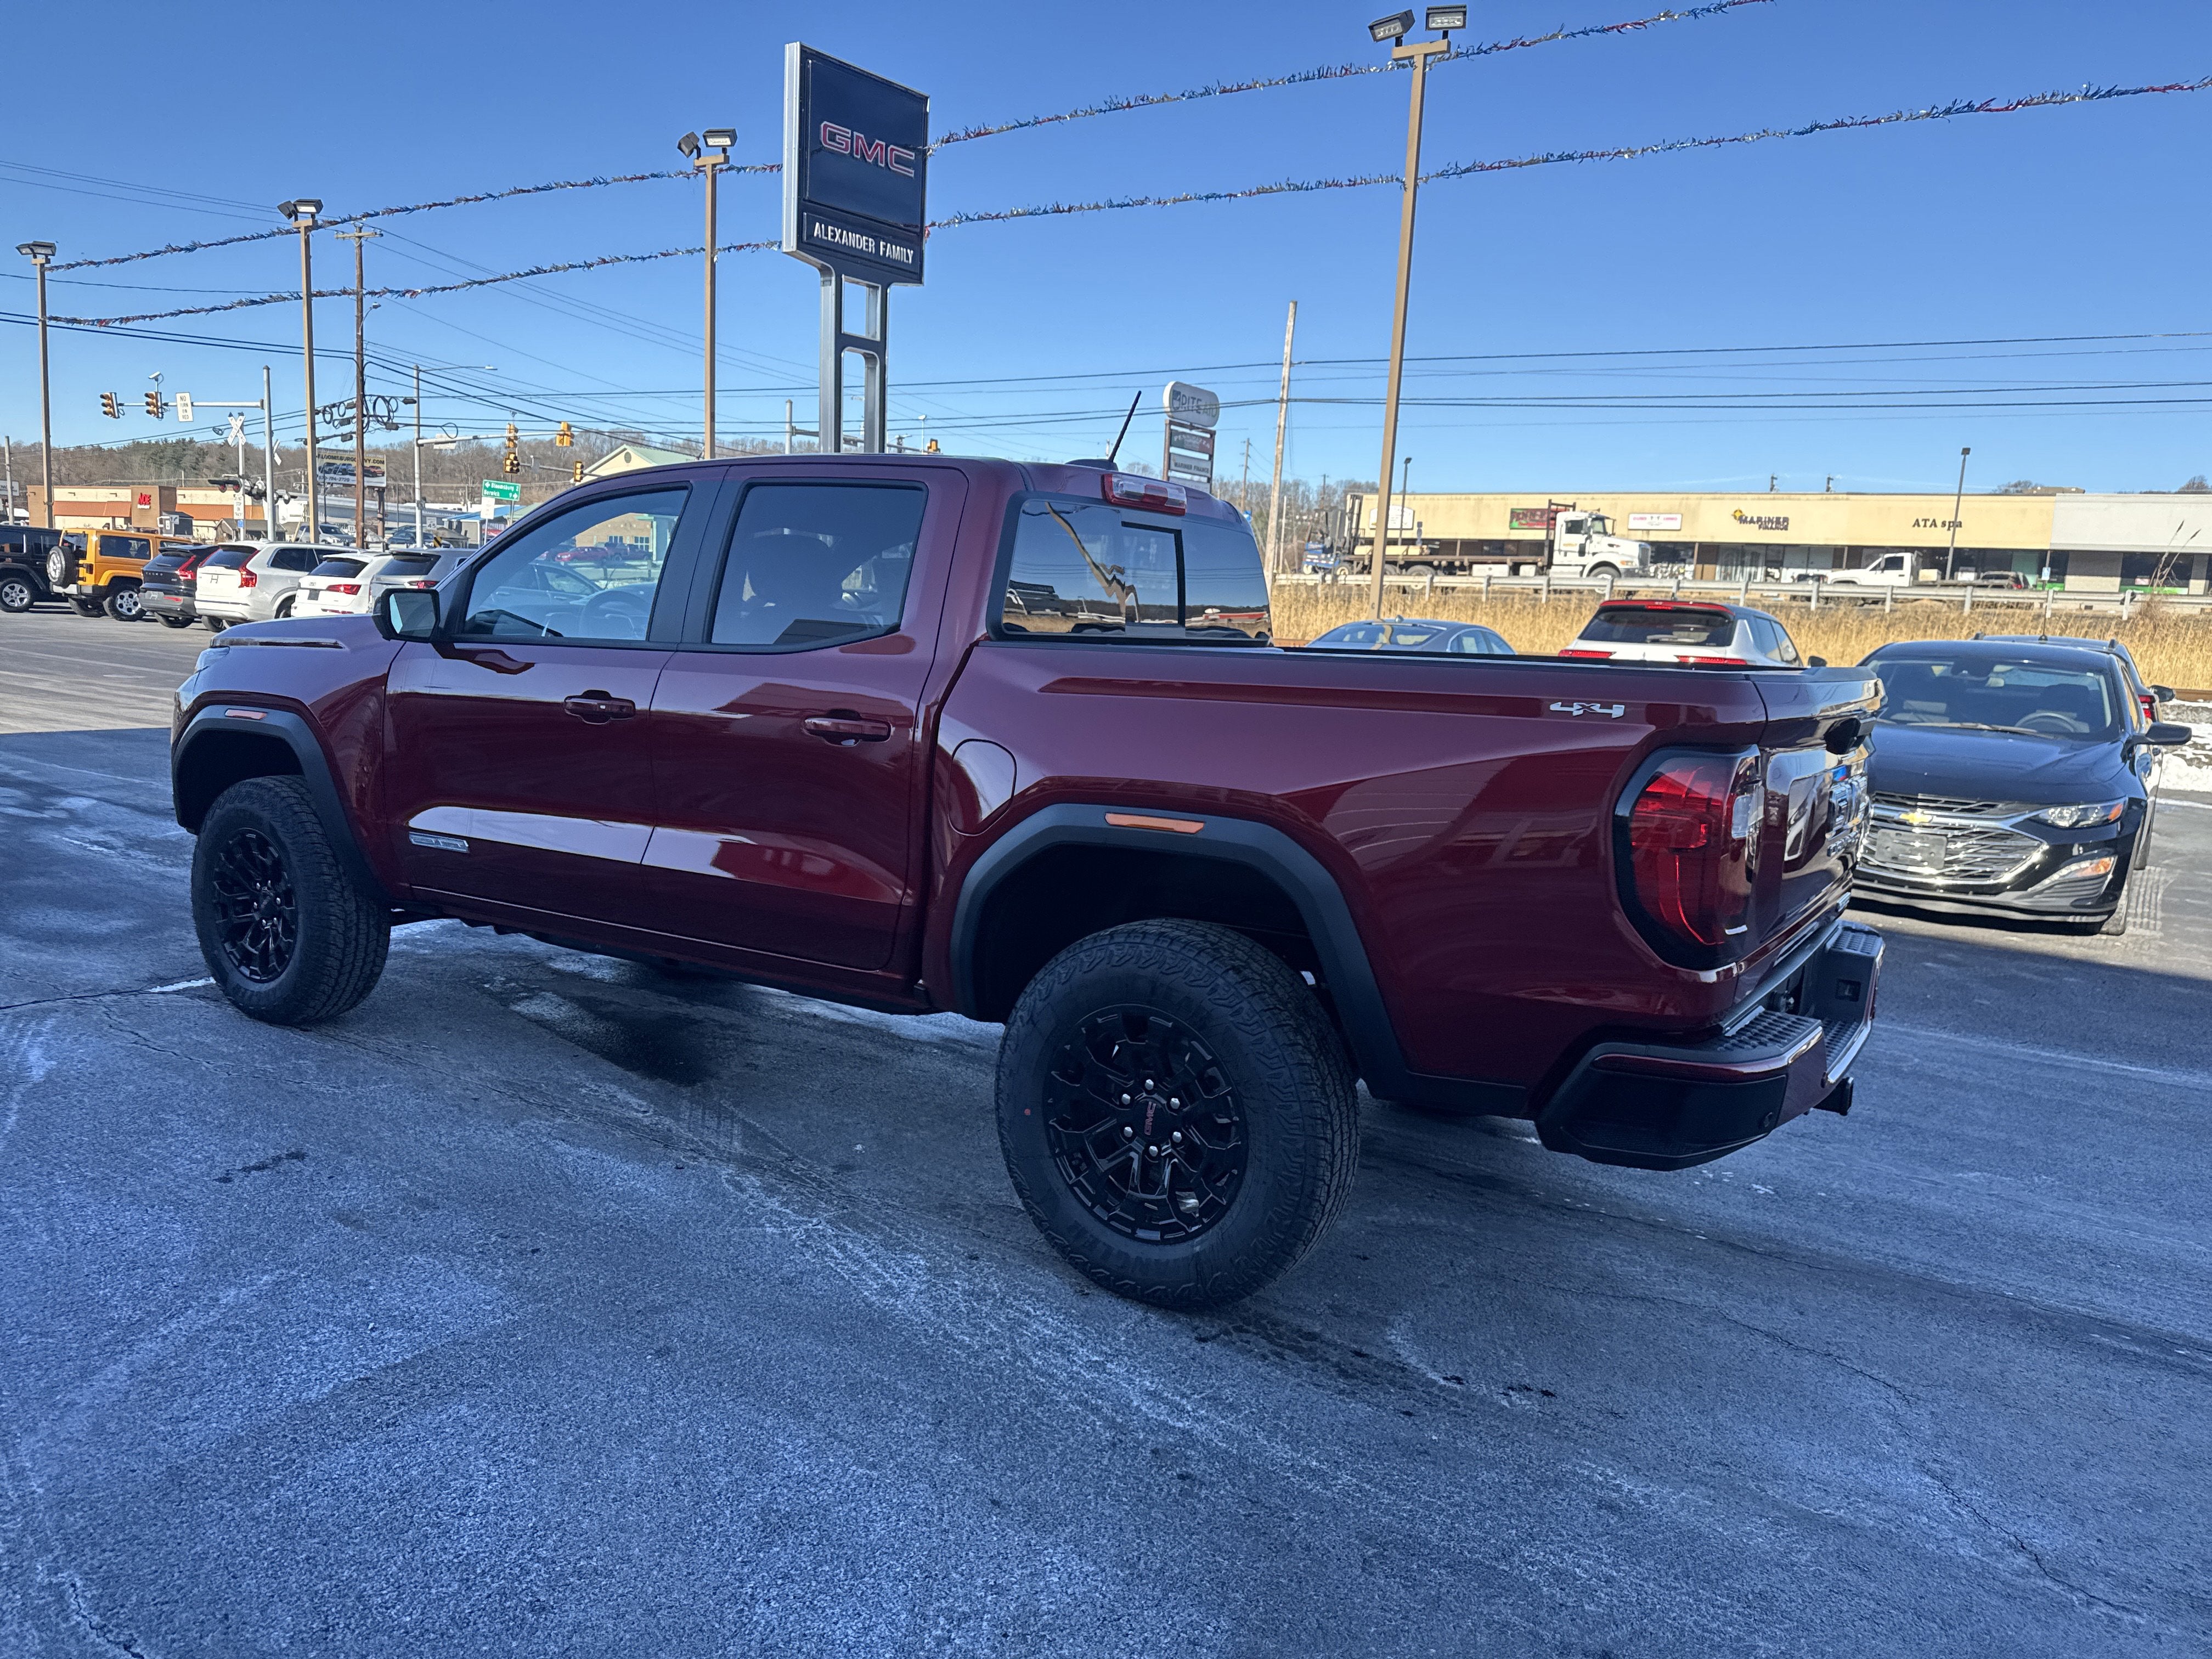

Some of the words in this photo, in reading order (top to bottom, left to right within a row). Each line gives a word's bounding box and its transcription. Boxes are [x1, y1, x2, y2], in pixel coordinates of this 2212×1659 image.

[821, 121, 915, 178] GMC
[814, 222, 875, 255] ALEXANDER
[879, 240, 914, 264] FAMILY
[317, 454, 385, 465] LOOMSBURGCVY.COM
[491, 482, 514, 492] Bloomsburg
[1739, 516, 1789, 525] MARINER
[1912, 518, 1938, 528] ATA
[1941, 520, 1962, 531] spa
[1144, 1101, 1156, 1136] GMC
